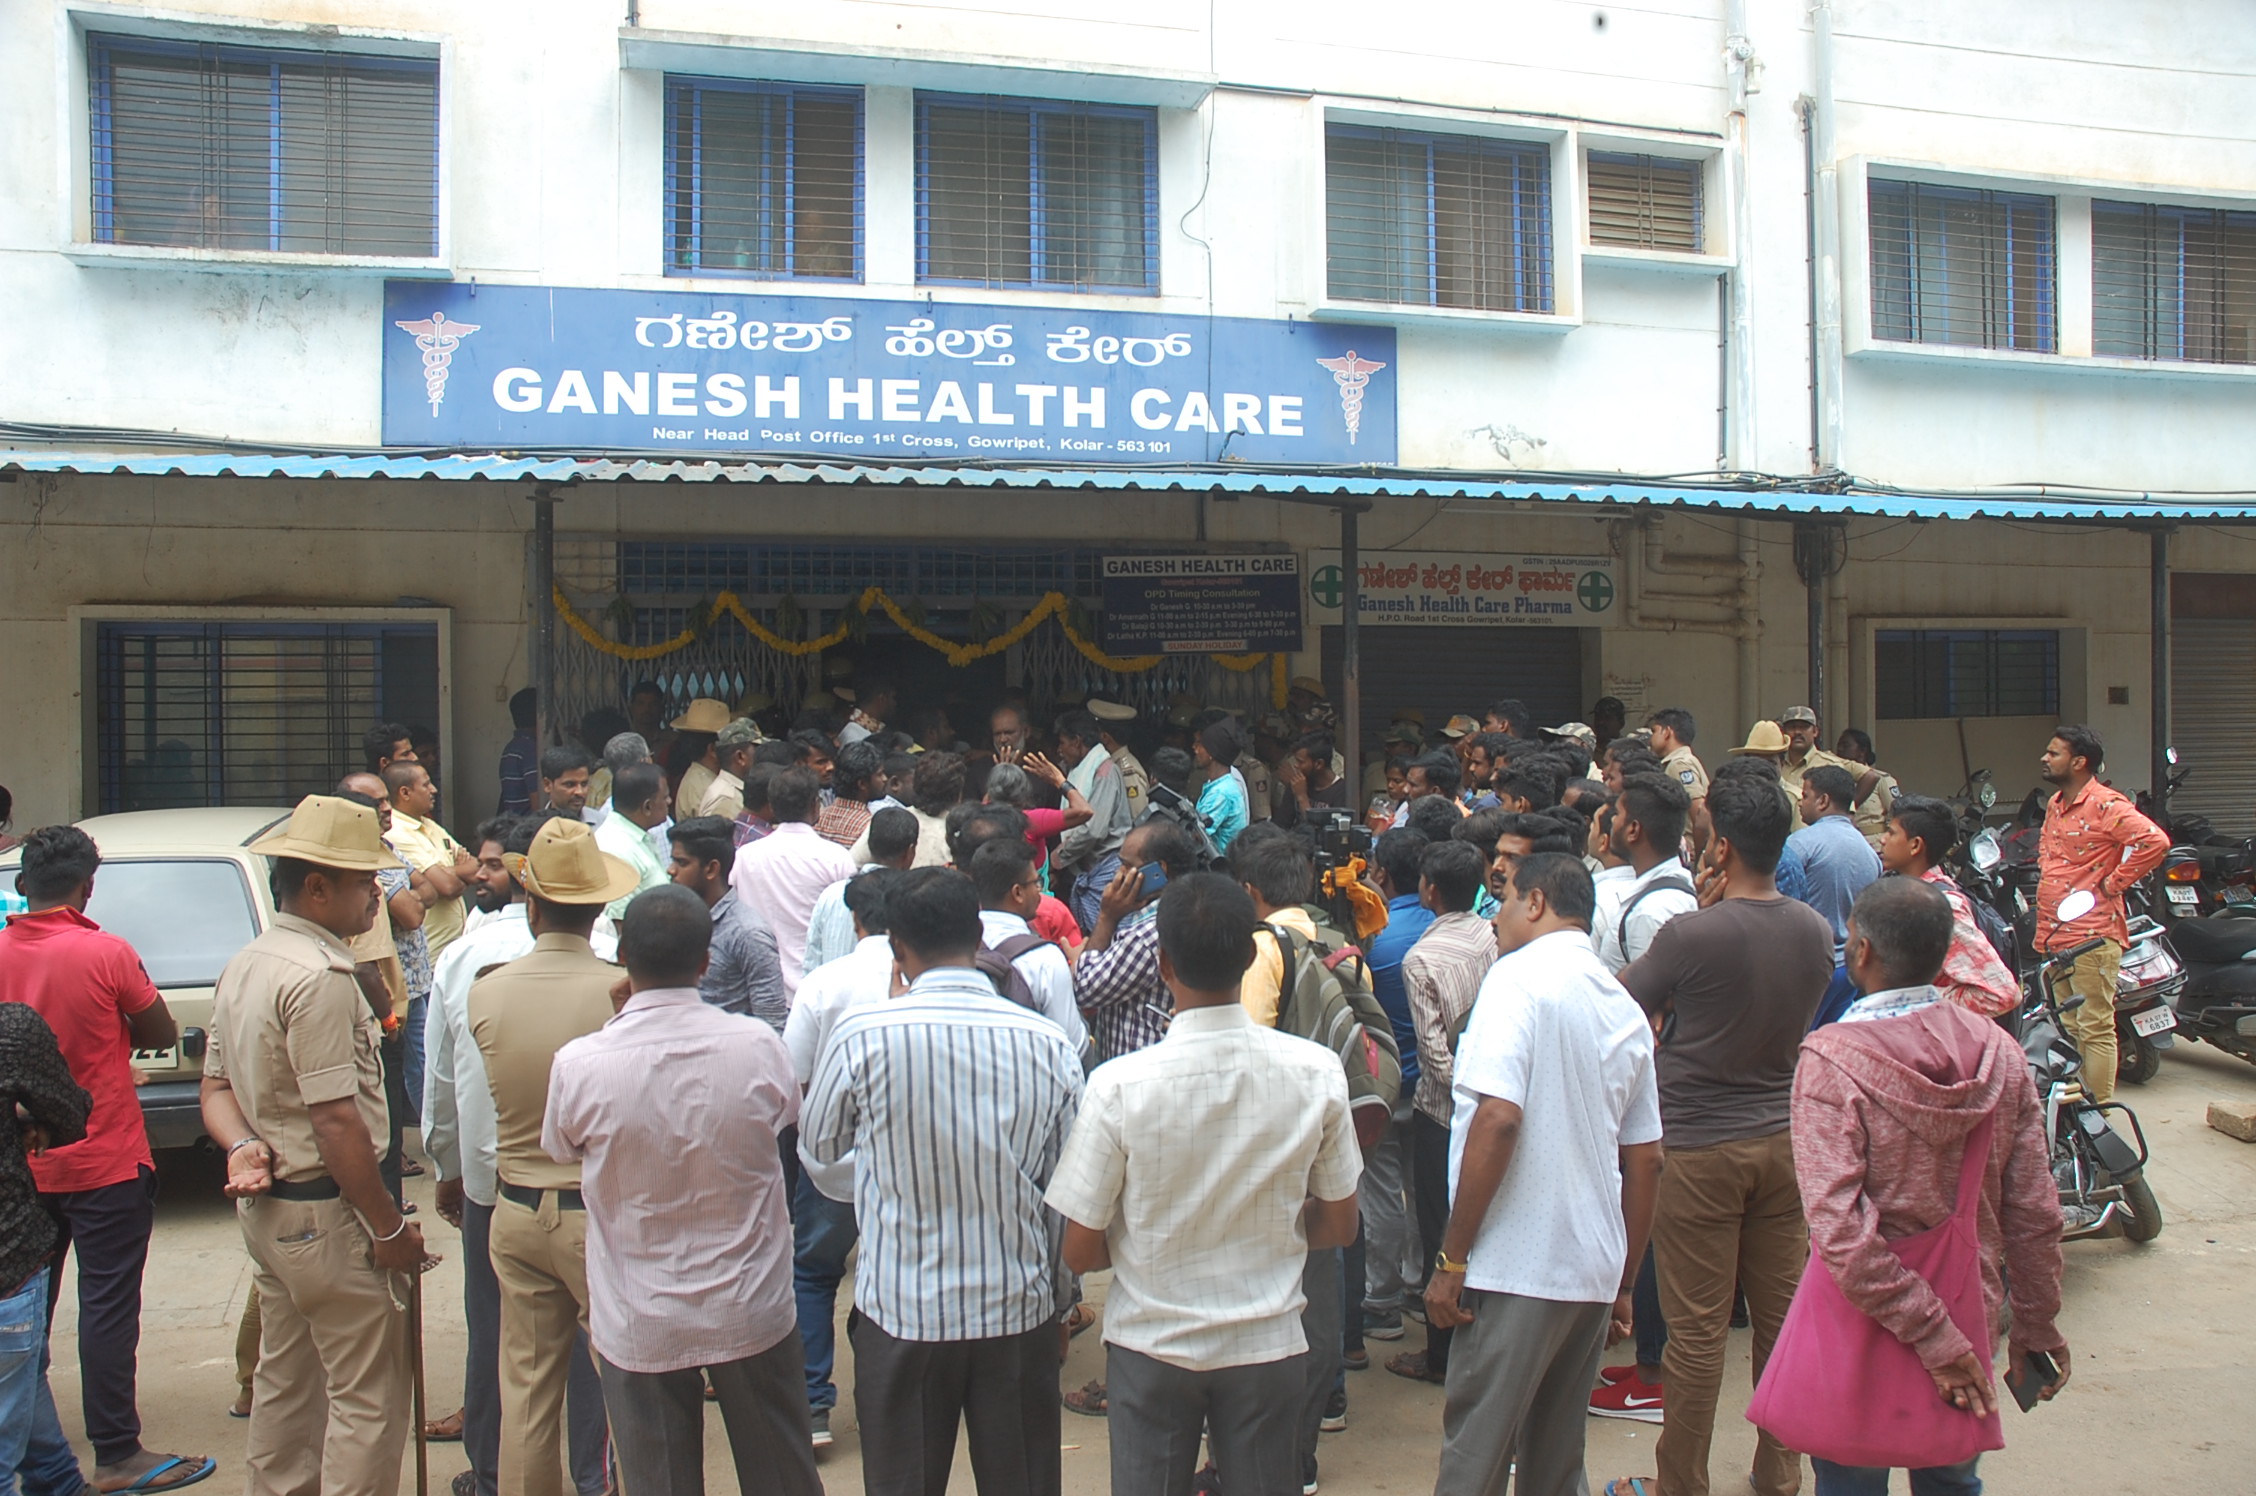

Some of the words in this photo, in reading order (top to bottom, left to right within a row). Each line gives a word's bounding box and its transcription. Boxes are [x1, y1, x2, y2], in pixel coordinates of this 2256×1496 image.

[635, 311, 852, 352] ಗಣೇಶ್
[885, 318, 1016, 366] ಹೆಲ್ತ್
[1046, 326, 1191, 367] ಕೇರ್
[493, 367, 800, 420] GANESH
[828, 376, 1106, 428] HEALTH
[1130, 387, 1304, 437] CARE
[653, 427, 694, 440] Near
[704, 428, 749, 442] Head
[761, 429, 801, 442] Post
[809, 430, 864, 444] Office
[873, 432, 895, 445] 1st
[902, 434, 959, 450] Cross,
[967, 436, 1052, 452] Gowripet,
[1060, 437, 1105, 451] Kolar
[1107, 560, 1176, 574] GANESH
[1182, 559, 1246, 573] HEALTH
[1251, 558, 1294, 572] CARE
[1145, 590, 1166, 598] OPD
[1168, 590, 1200, 600] Timing
[1202, 588, 1260, 598] Consultation
[1357, 595, 1415, 611] Ganesh
[1420, 595, 1470, 612] Health
[1475, 597, 1509, 613] Care
[1514, 597, 1573, 614] Pharma
[1404, 615, 1425, 623] Road
[1427, 615, 1439, 623] 1st
[1441, 615, 1464, 623] Cross
[1168, 642, 1202, 650] SUNDAY
[1206, 641, 1242, 649] HOLIDAY
[2149, 1019, 2169, 1031] 6837
